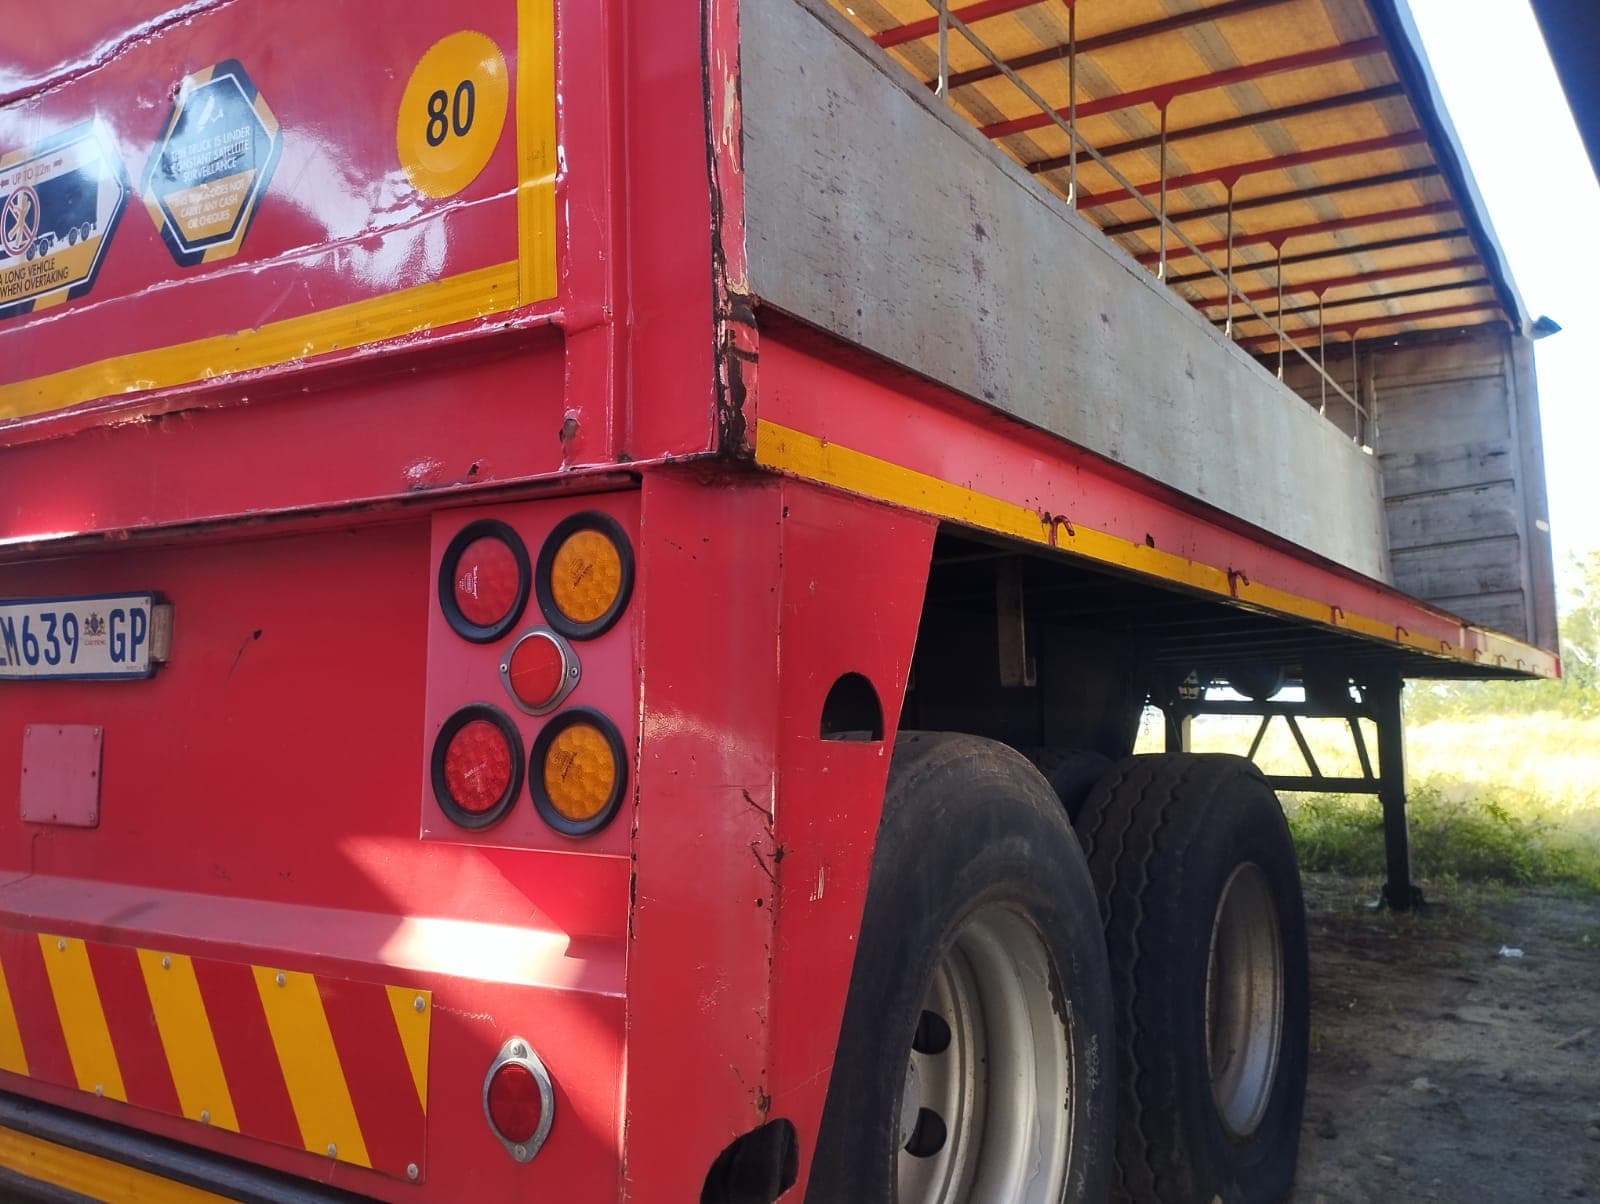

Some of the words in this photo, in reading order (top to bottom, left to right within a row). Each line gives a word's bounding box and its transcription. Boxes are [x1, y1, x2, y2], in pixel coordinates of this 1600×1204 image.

[426, 79, 476, 147] 80
[214, 135, 222, 147] IS
[223, 126, 250, 145] UNDER
[214, 139, 249, 161] SATELLITE
[11, 173, 22, 186] UP
[23, 168, 34, 182] TO
[183, 156, 237, 183] SURVEILLANCE
[203, 200, 218, 212] ANY
[0, 282, 23, 298] WHEN
[25, 266, 69, 292] OVERTAKING
[4, 267, 27, 284] LONG
[28, 257, 56, 276] VEHICLE
[109, 607, 147, 663] GP
